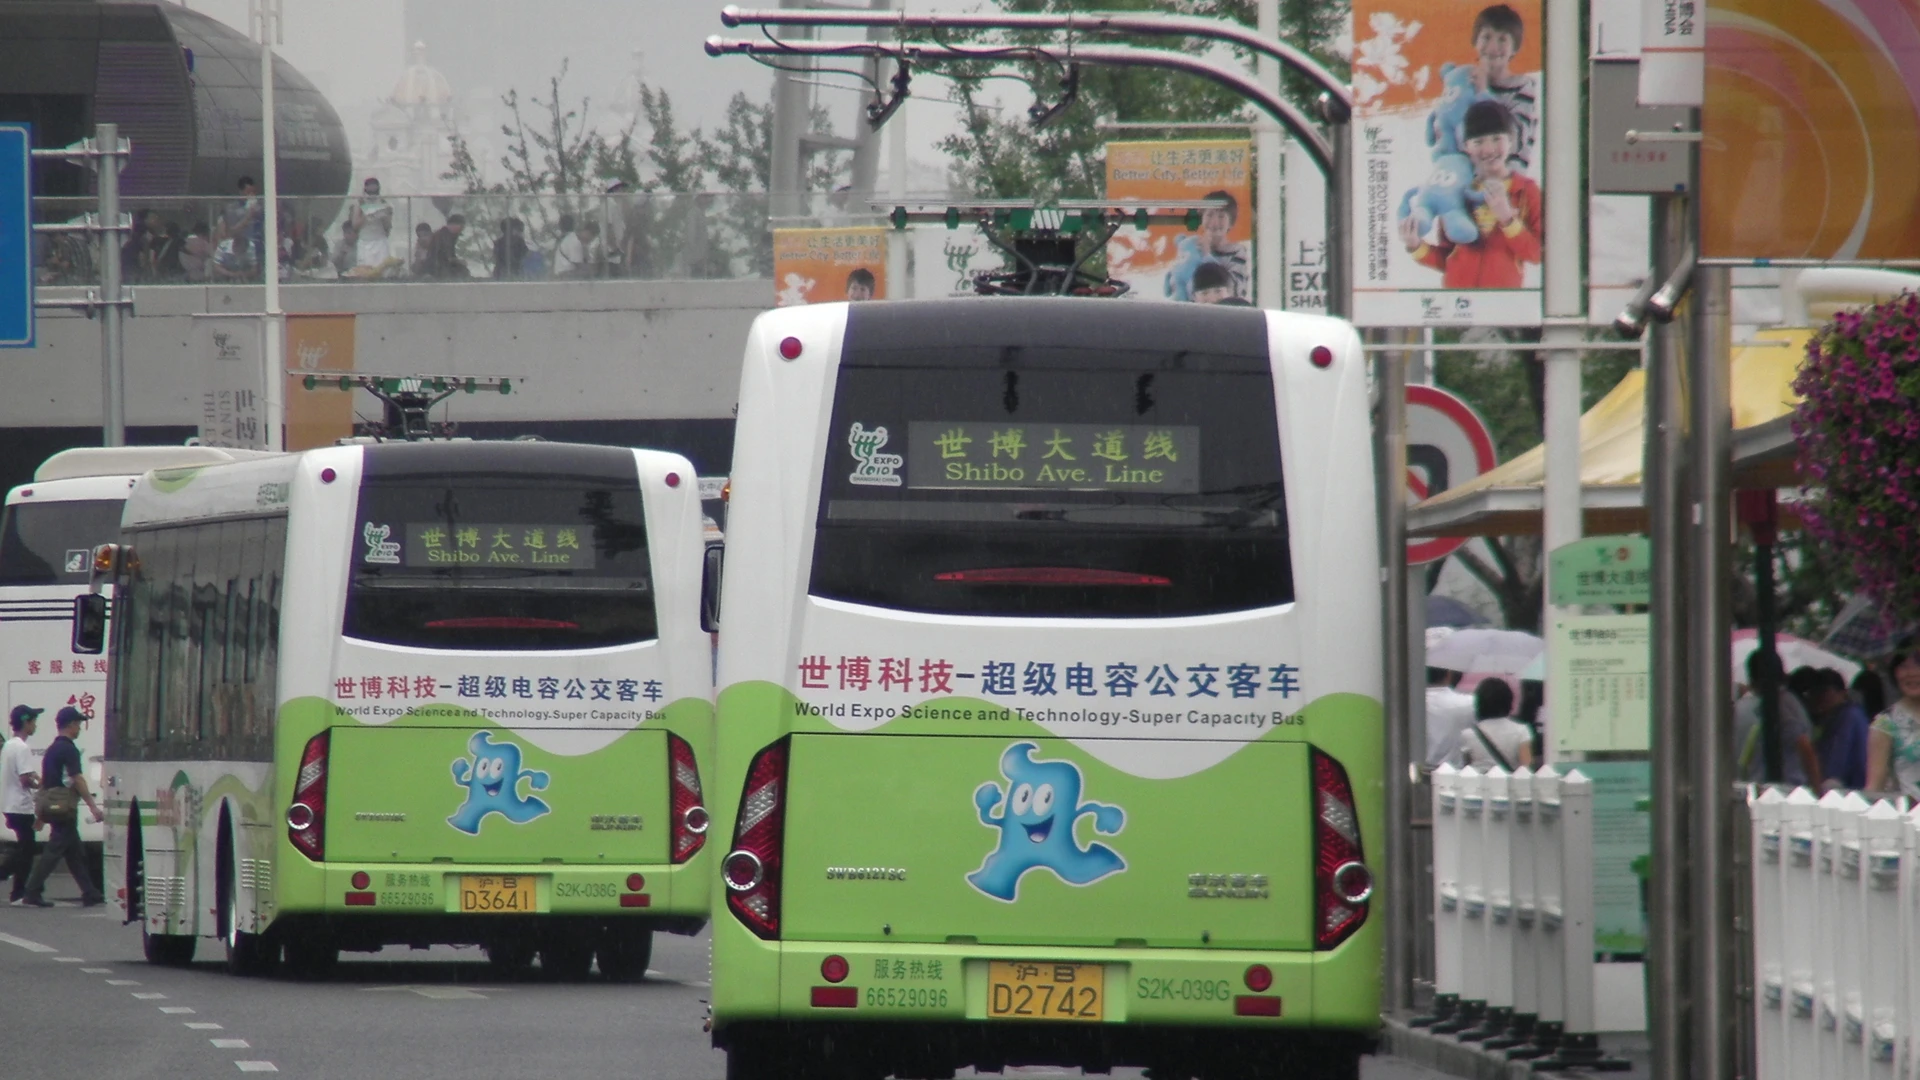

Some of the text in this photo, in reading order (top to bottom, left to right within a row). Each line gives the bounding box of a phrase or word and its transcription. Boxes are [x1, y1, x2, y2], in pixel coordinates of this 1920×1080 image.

[934, 428, 1178, 462] 世博大道线
[873, 456, 900, 465] EXPO
[946, 463, 1163, 483] Shibo Ave. Line
[421, 527, 579, 549] 世博大道线
[428, 550, 571, 564] Shibo Ave. Line
[28, 660, 108, 675] 客服热线
[798, 655, 1300, 699] 世博科技-超级电容公交客车
[334, 675, 664, 703] 世博科技-超级电容公交客车
[335, 706, 370, 716] World
[373, 706, 403, 718] Expo
[406, 707, 454, 717] Science
[455, 708, 478, 718] and
[591, 710, 642, 722] Capacity
[646, 711, 667, 720] Bus
[795, 703, 1305, 728] World Expo Science and Technology-Super Capacity Bus
[385, 872, 431, 888] 服务热线
[464, 891, 528, 910] D3641
[556, 883, 617, 898] S2K-038G
[873, 960, 943, 980] 服务热线
[866, 988, 948, 1008] 66529096
[1137, 978, 1230, 1001] S2K-039G
[992, 984, 1098, 1017] D2742
